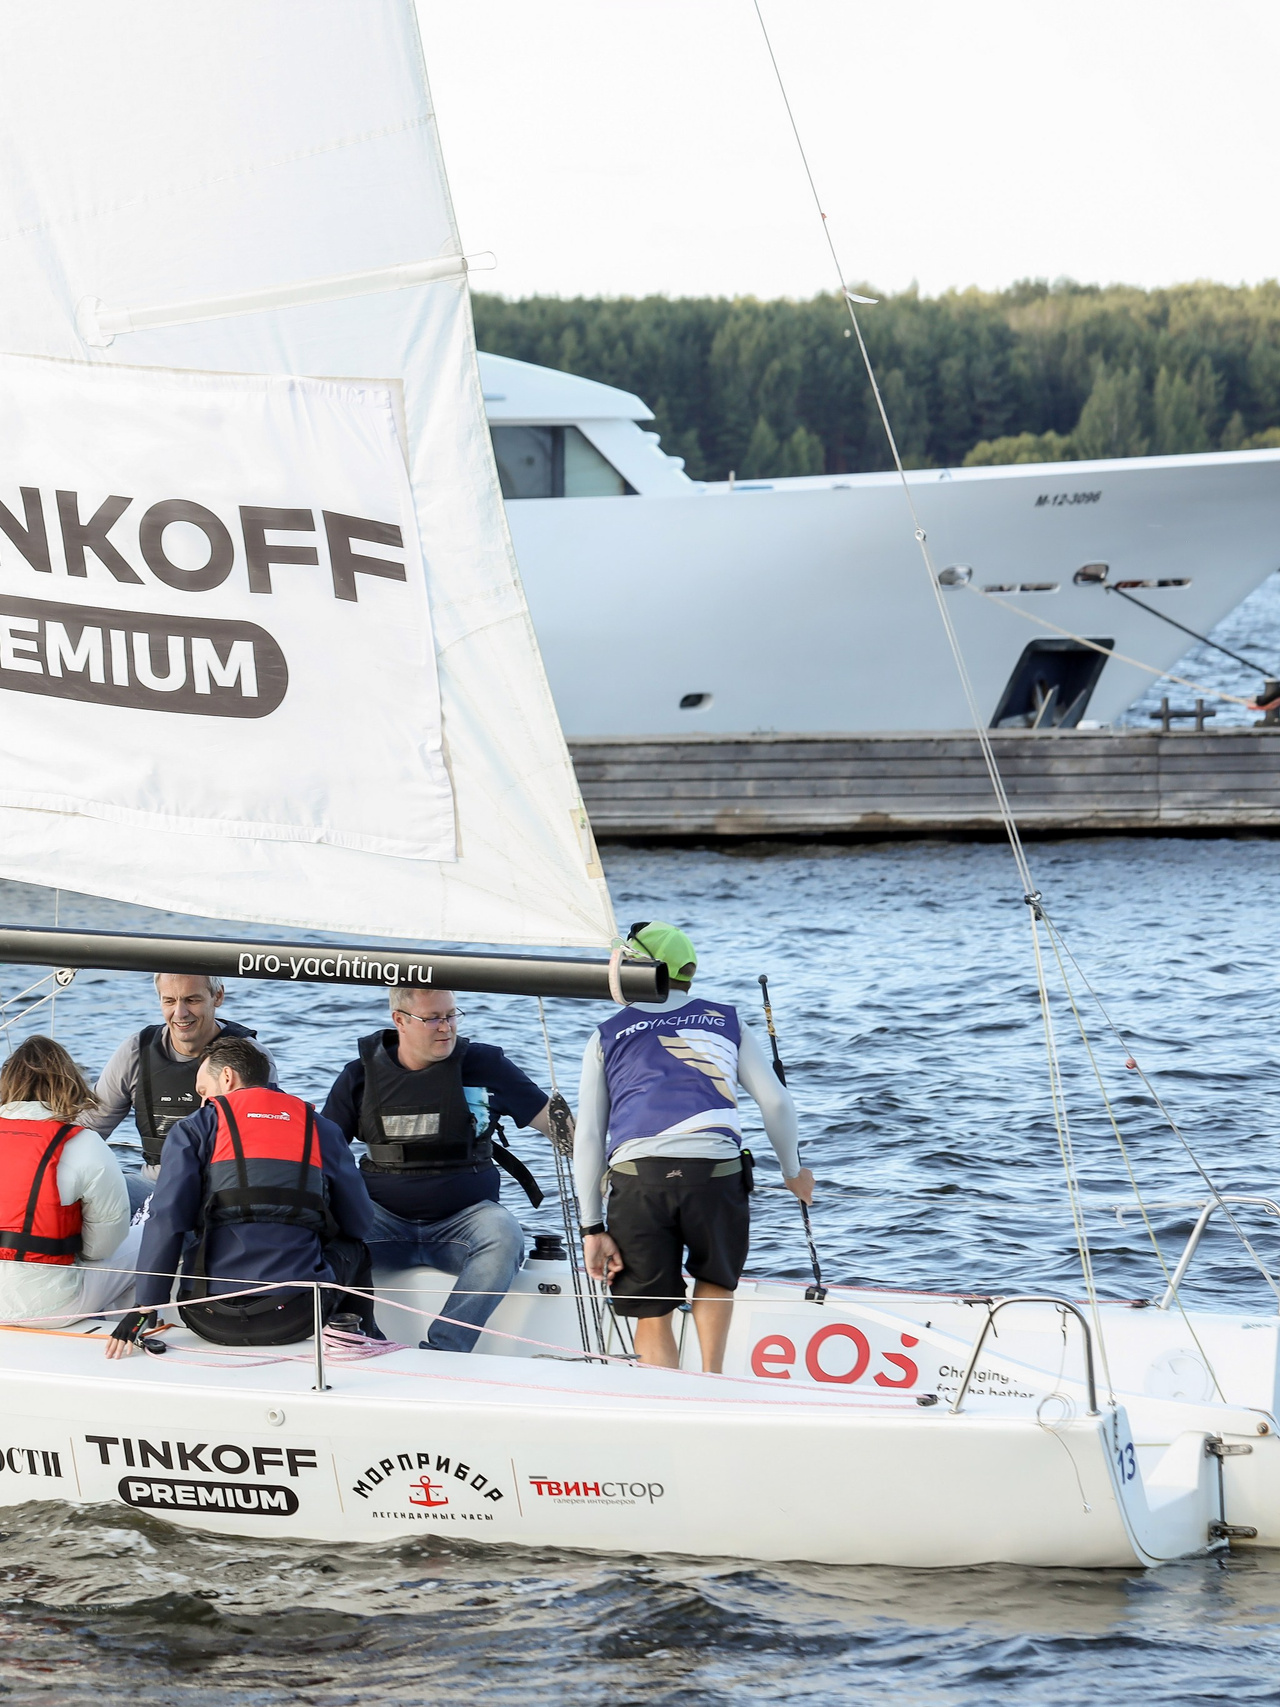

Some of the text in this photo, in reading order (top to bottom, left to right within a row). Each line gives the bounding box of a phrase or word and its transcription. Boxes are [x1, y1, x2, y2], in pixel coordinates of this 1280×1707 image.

[238, 951, 433, 986] pro-yachting.ru
[85, 1434, 318, 1477] TINKOFF
[1117, 1442, 1136, 1485] 13
[128, 1481, 289, 1511] PREMIUM
[352, 1452, 504, 1502] МОРПРИБОР
[372, 1511, 494, 1521] ЛЕГЕНДАРНЫЕ ЧАСЫ
